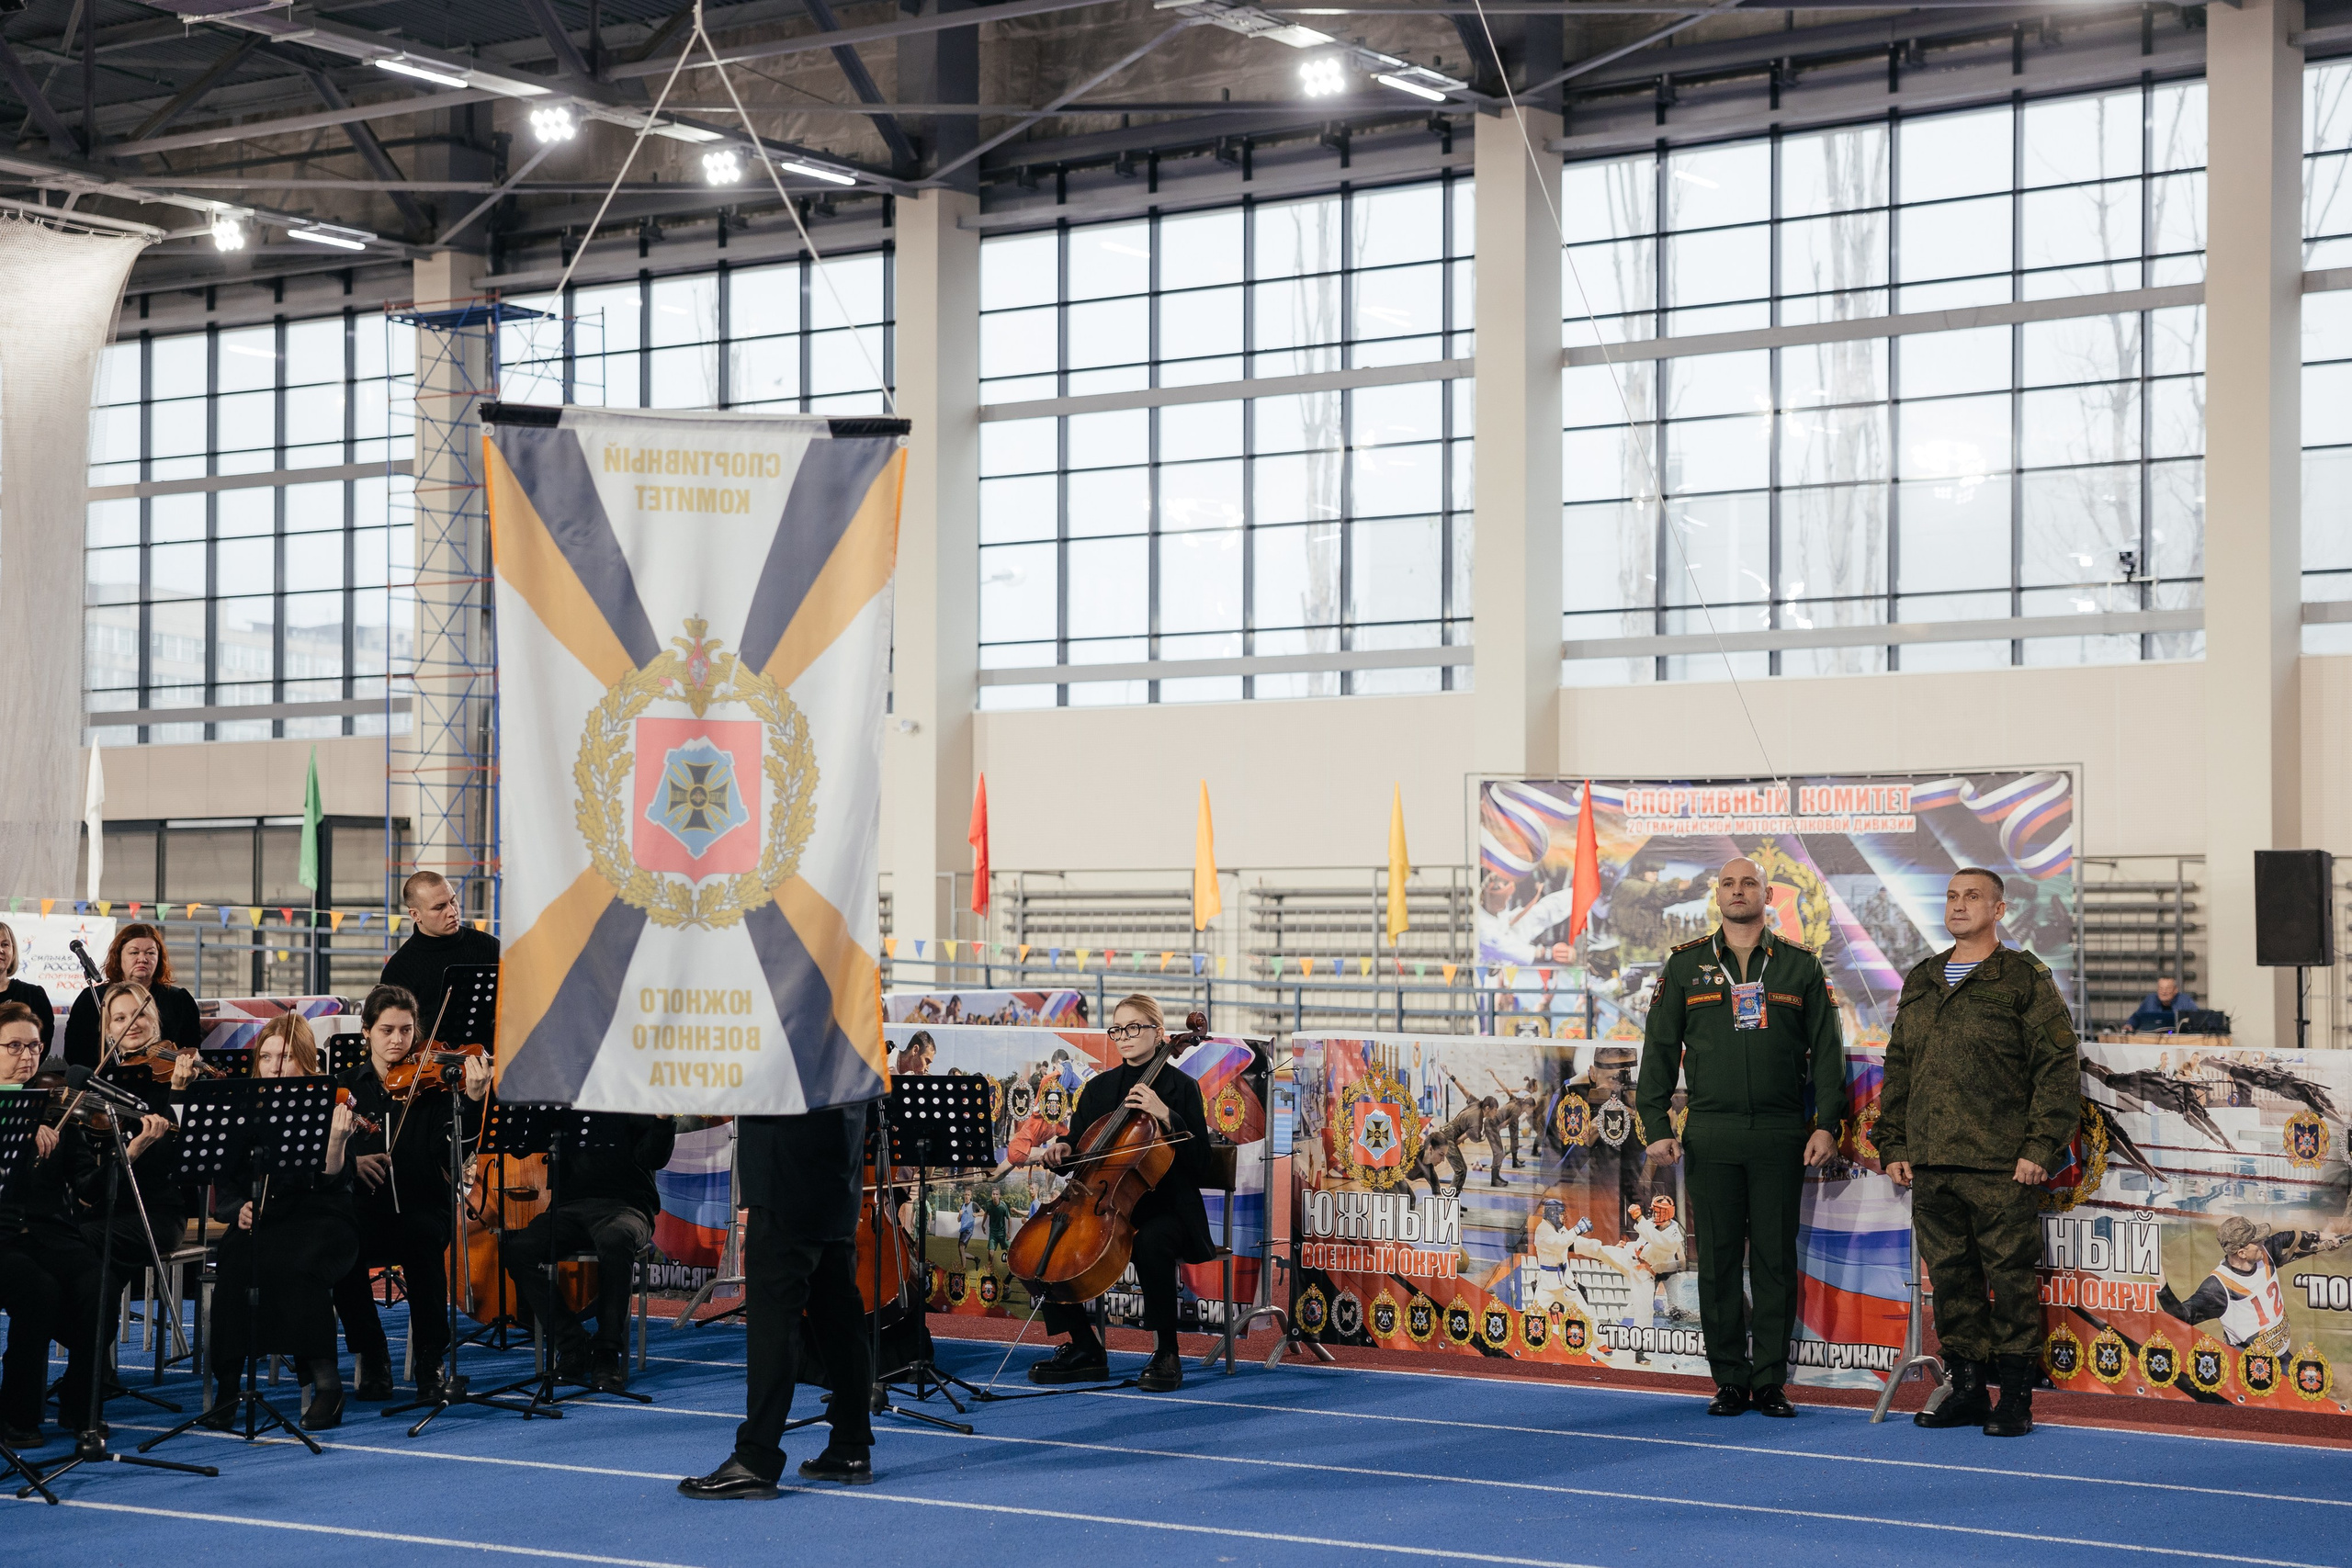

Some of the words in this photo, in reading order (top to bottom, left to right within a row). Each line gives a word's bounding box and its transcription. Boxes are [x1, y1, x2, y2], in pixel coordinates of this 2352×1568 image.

[1624, 782, 1790, 816] СПОРТИВНЫЙ
[1800, 785, 1913, 814] КОМИТЕТ
[1628, 820, 1644, 834] 20
[1645, 817, 1733, 836] ГВАРДЕЙСКОЙ
[1735, 817, 1850, 834] МОТОСТРЕЛКОВОЙ
[1853, 818, 1915, 833] ДИВИЗИИ
[43, 963, 85, 971] РОССИ
[1302, 1187, 1461, 1246] ЮЖНЫЙ
[1302, 1242, 1396, 1275] ВОЕННЫЙ
[1398, 1247, 1461, 1279] ОКРУГ
[2035, 1212, 2160, 1275] НЫЙ
[2082, 1278, 2162, 1313] ОКРУГ
[1598, 1325, 1655, 1351] “ТВОЯ
[1658, 1328, 1708, 1358] ПОБЕ
[1789, 1339, 1826, 1367] ОИХ
